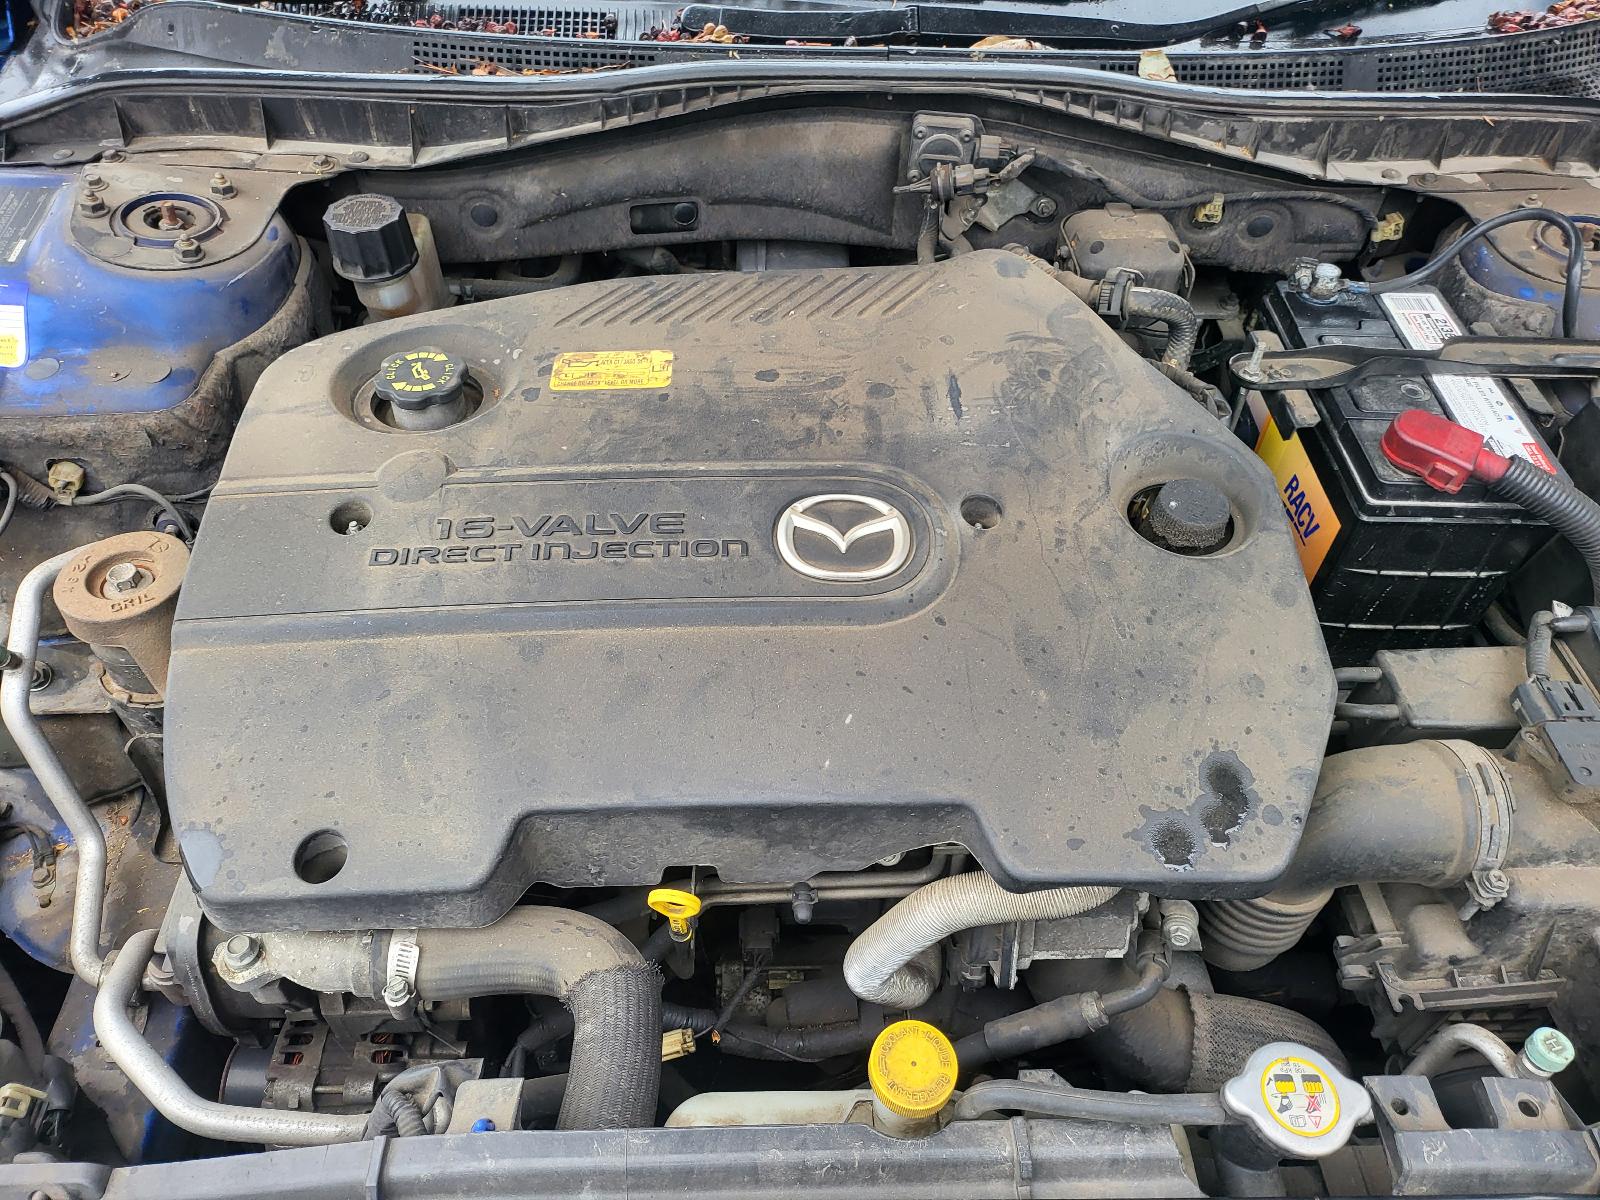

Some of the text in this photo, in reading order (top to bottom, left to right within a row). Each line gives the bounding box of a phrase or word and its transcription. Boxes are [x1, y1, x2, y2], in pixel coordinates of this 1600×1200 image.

[386, 358, 404, 380] CLICK
[437, 363, 455, 385] CLICK
[1283, 474, 1320, 538] RACV
[436, 512, 685, 540] 16-VALVE
[368, 538, 749, 566] DIRECT INJECTION
[1545, 1038, 1563, 1051] H
[880, 1025, 952, 1102] COOLANT LIQUIDE REFRIGERANT
